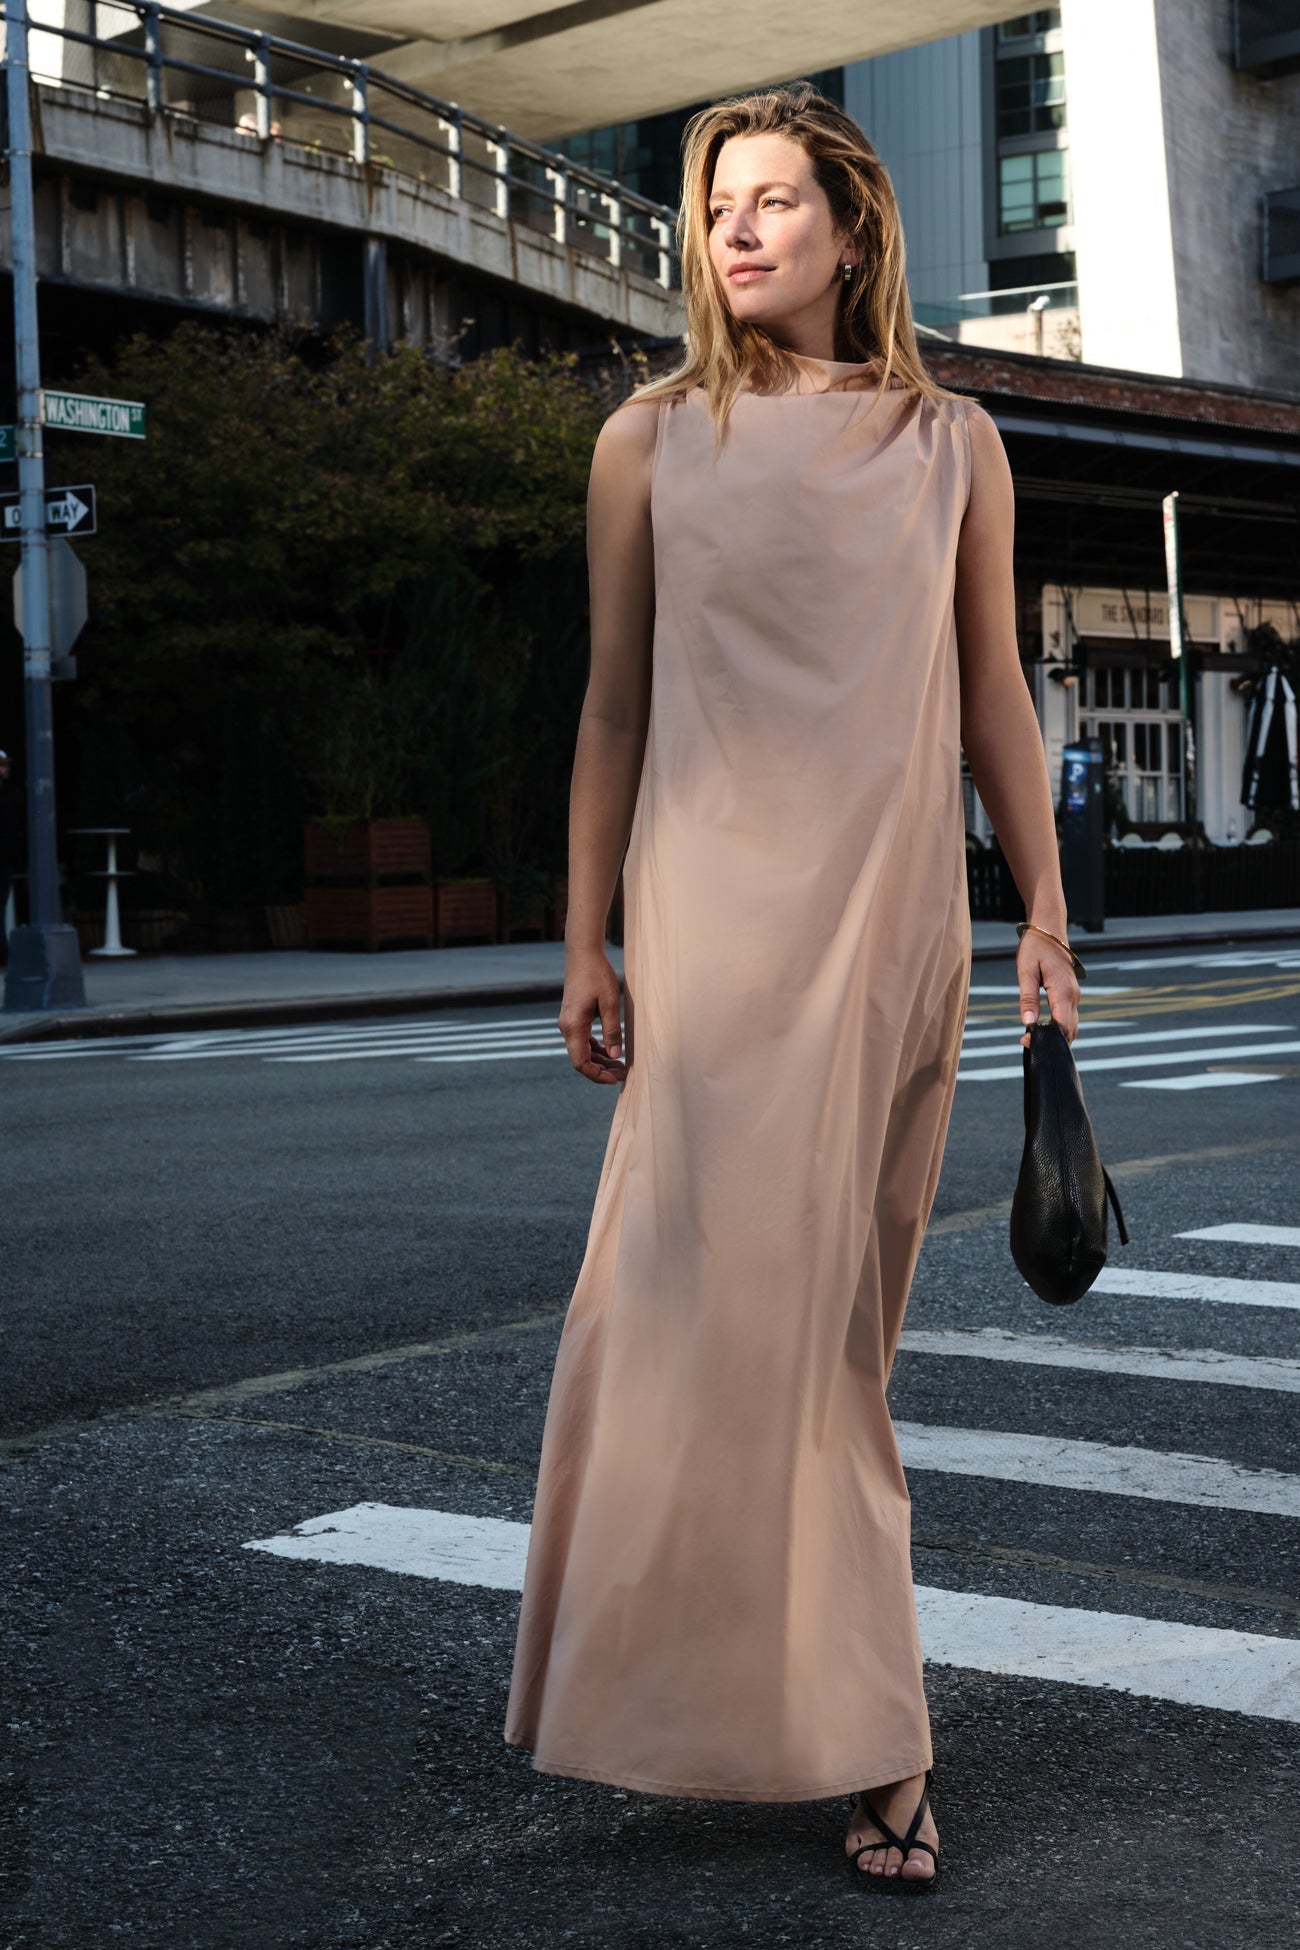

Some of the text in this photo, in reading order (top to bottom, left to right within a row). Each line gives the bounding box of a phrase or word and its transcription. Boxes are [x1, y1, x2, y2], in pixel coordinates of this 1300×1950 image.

[46, 396, 142, 432] WASHINGTON ST
[51, 503, 79, 520] WAY
[1101, 604, 1118, 623] THE
[1120, 605, 1163, 625] STANDRD
